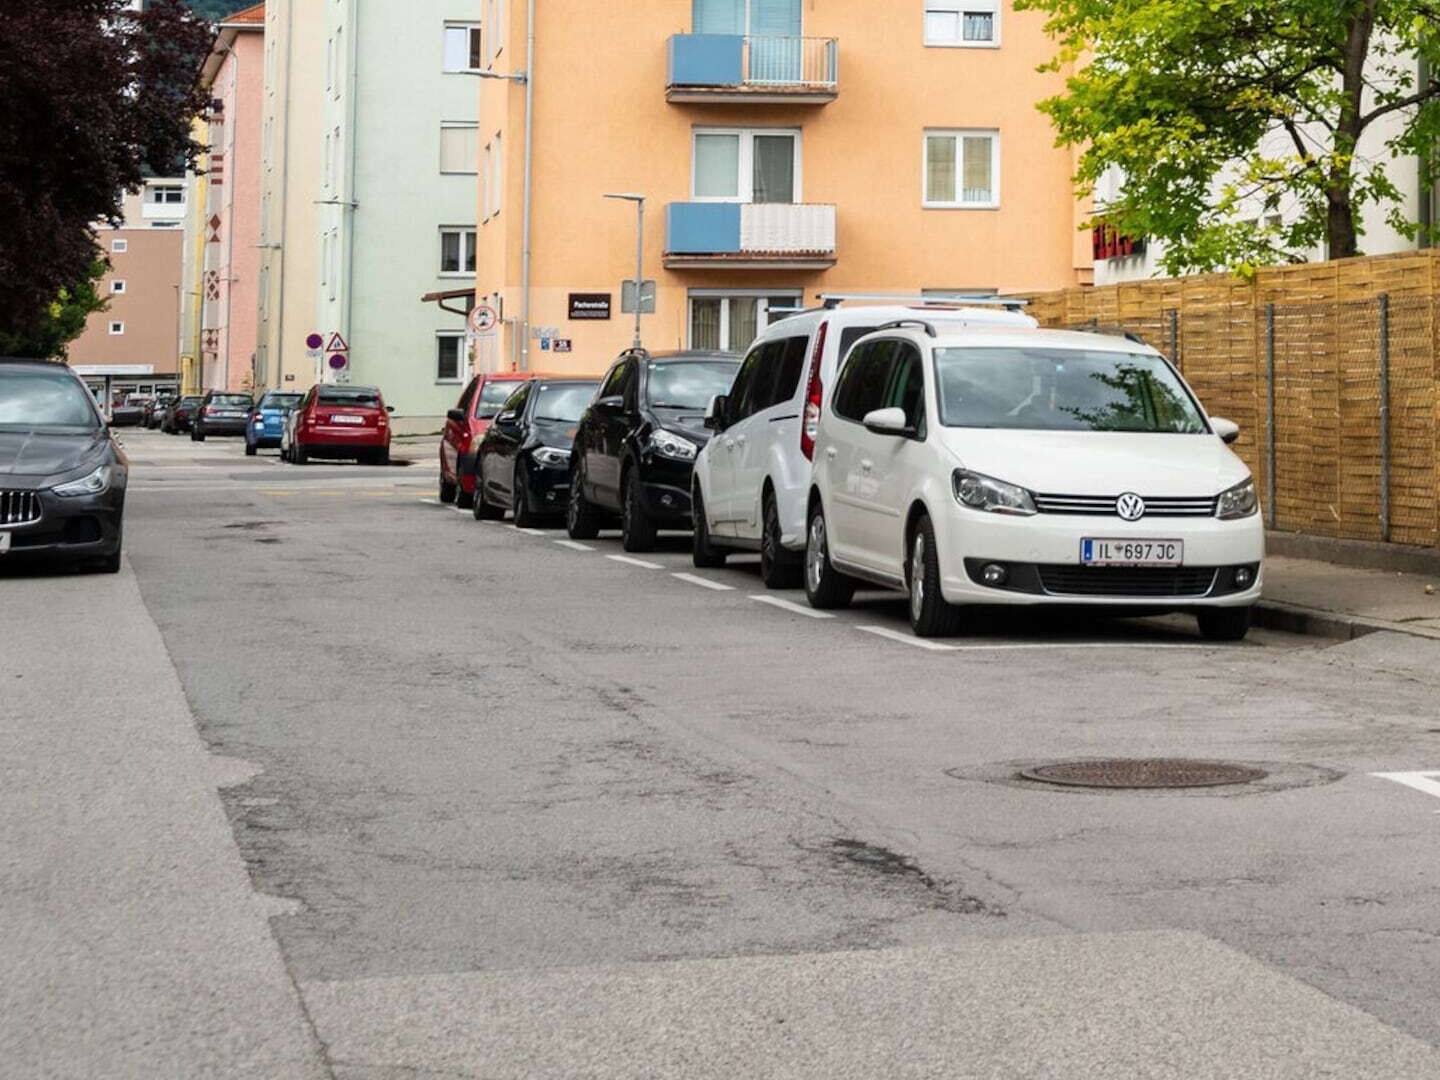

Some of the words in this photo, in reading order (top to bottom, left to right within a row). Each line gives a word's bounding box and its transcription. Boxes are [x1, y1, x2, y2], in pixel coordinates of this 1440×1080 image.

[1117, 492, 1145, 521] VW
[1124, 543, 1153, 560] 697
[1156, 544, 1175, 560] JC
